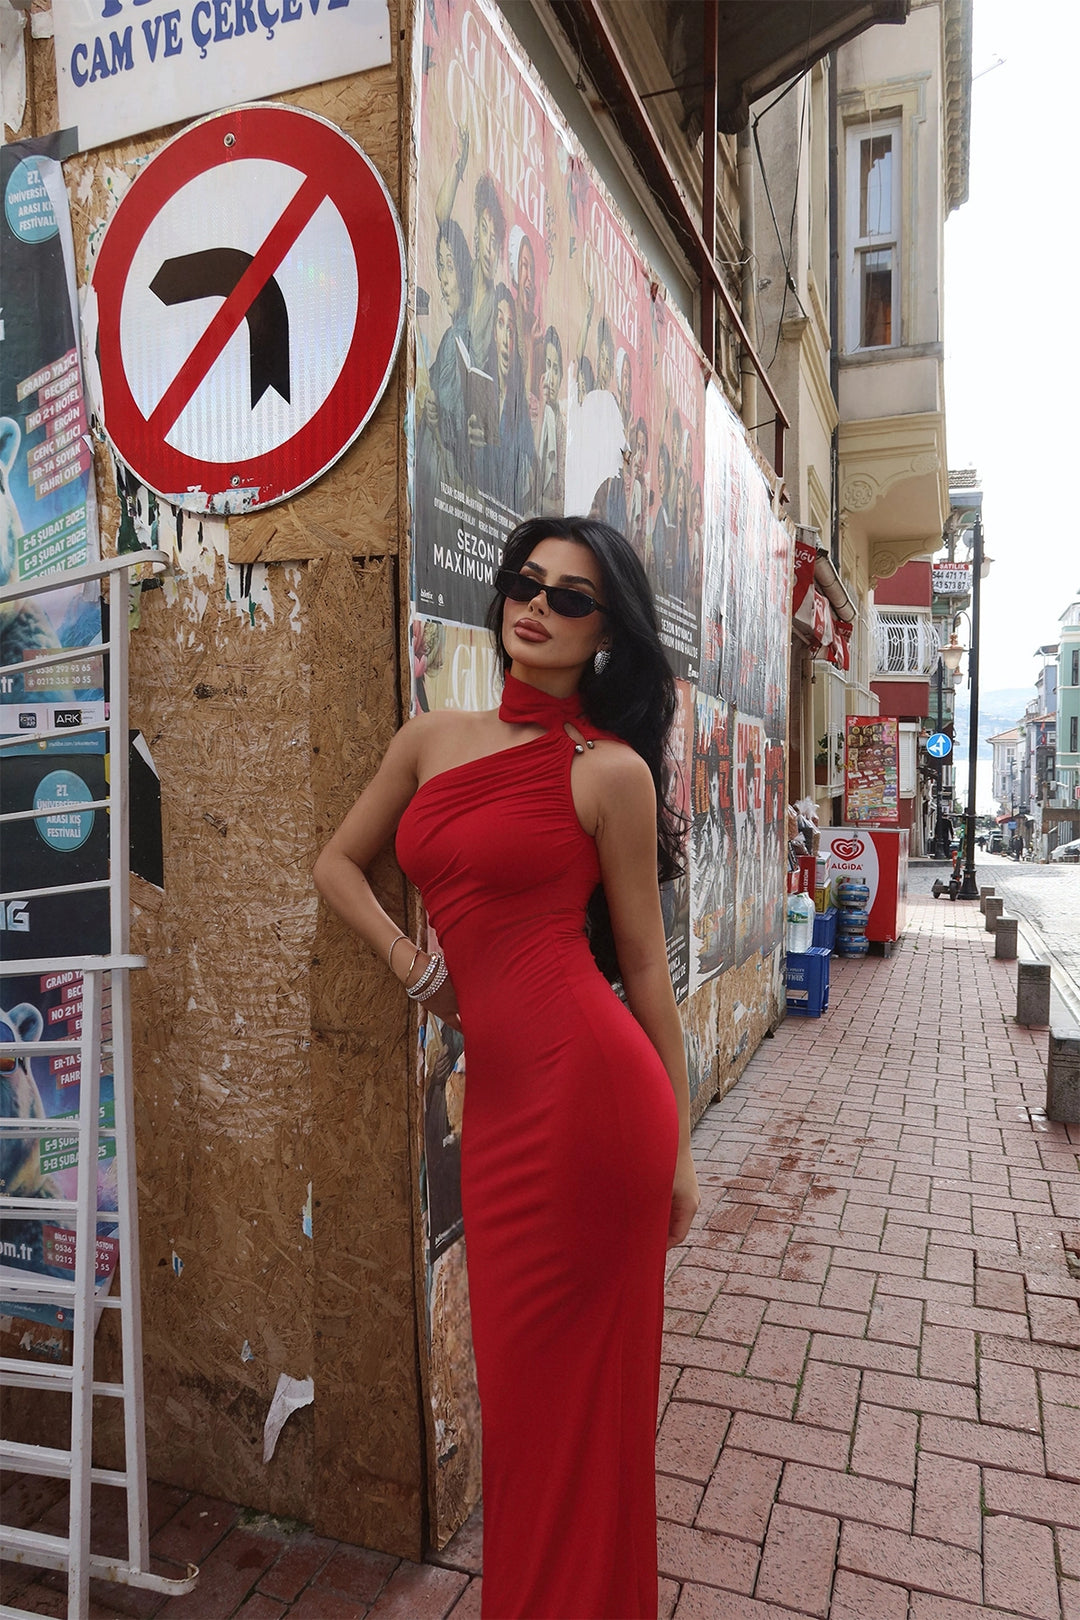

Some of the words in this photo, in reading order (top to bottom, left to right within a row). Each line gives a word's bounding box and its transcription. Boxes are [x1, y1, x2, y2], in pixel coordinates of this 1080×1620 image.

[71, 26, 135, 87] CAM
[142, 9, 183, 63] VE
[191, 0, 350, 59] ÇERÇE
[8, 185, 48, 205] ÜNİVERSİT
[18, 201, 41, 217] ARASI
[43, 406, 54, 420] 21
[65, 506, 85, 528] 2025
[66, 527, 86, 548] 2025
[457, 528, 495, 563] SEZON
[66, 548, 86, 568] 2025
[433, 543, 493, 586] MAXIMUM
[56, 713, 80, 724] ARK
[56, 784, 69, 797] 27.
[46, 814, 69, 824] ARASI
[70, 814, 82, 827] KIŞ
[47, 826, 82, 838] FESTİVALİ
[45, 972, 72, 989] GRAND
[51, 1008, 63, 1021] NO
[65, 1006, 76, 1017] 21
[53, 1056, 74, 1070] ER-TA
[60, 1071, 81, 1085] FAHR
[44, 1139, 57, 1152] 6-9
[59, 1153, 79, 1169] ŞUBA
[54, 1243, 72, 1254] 0536
[55, 1254, 73, 1264] 0212
